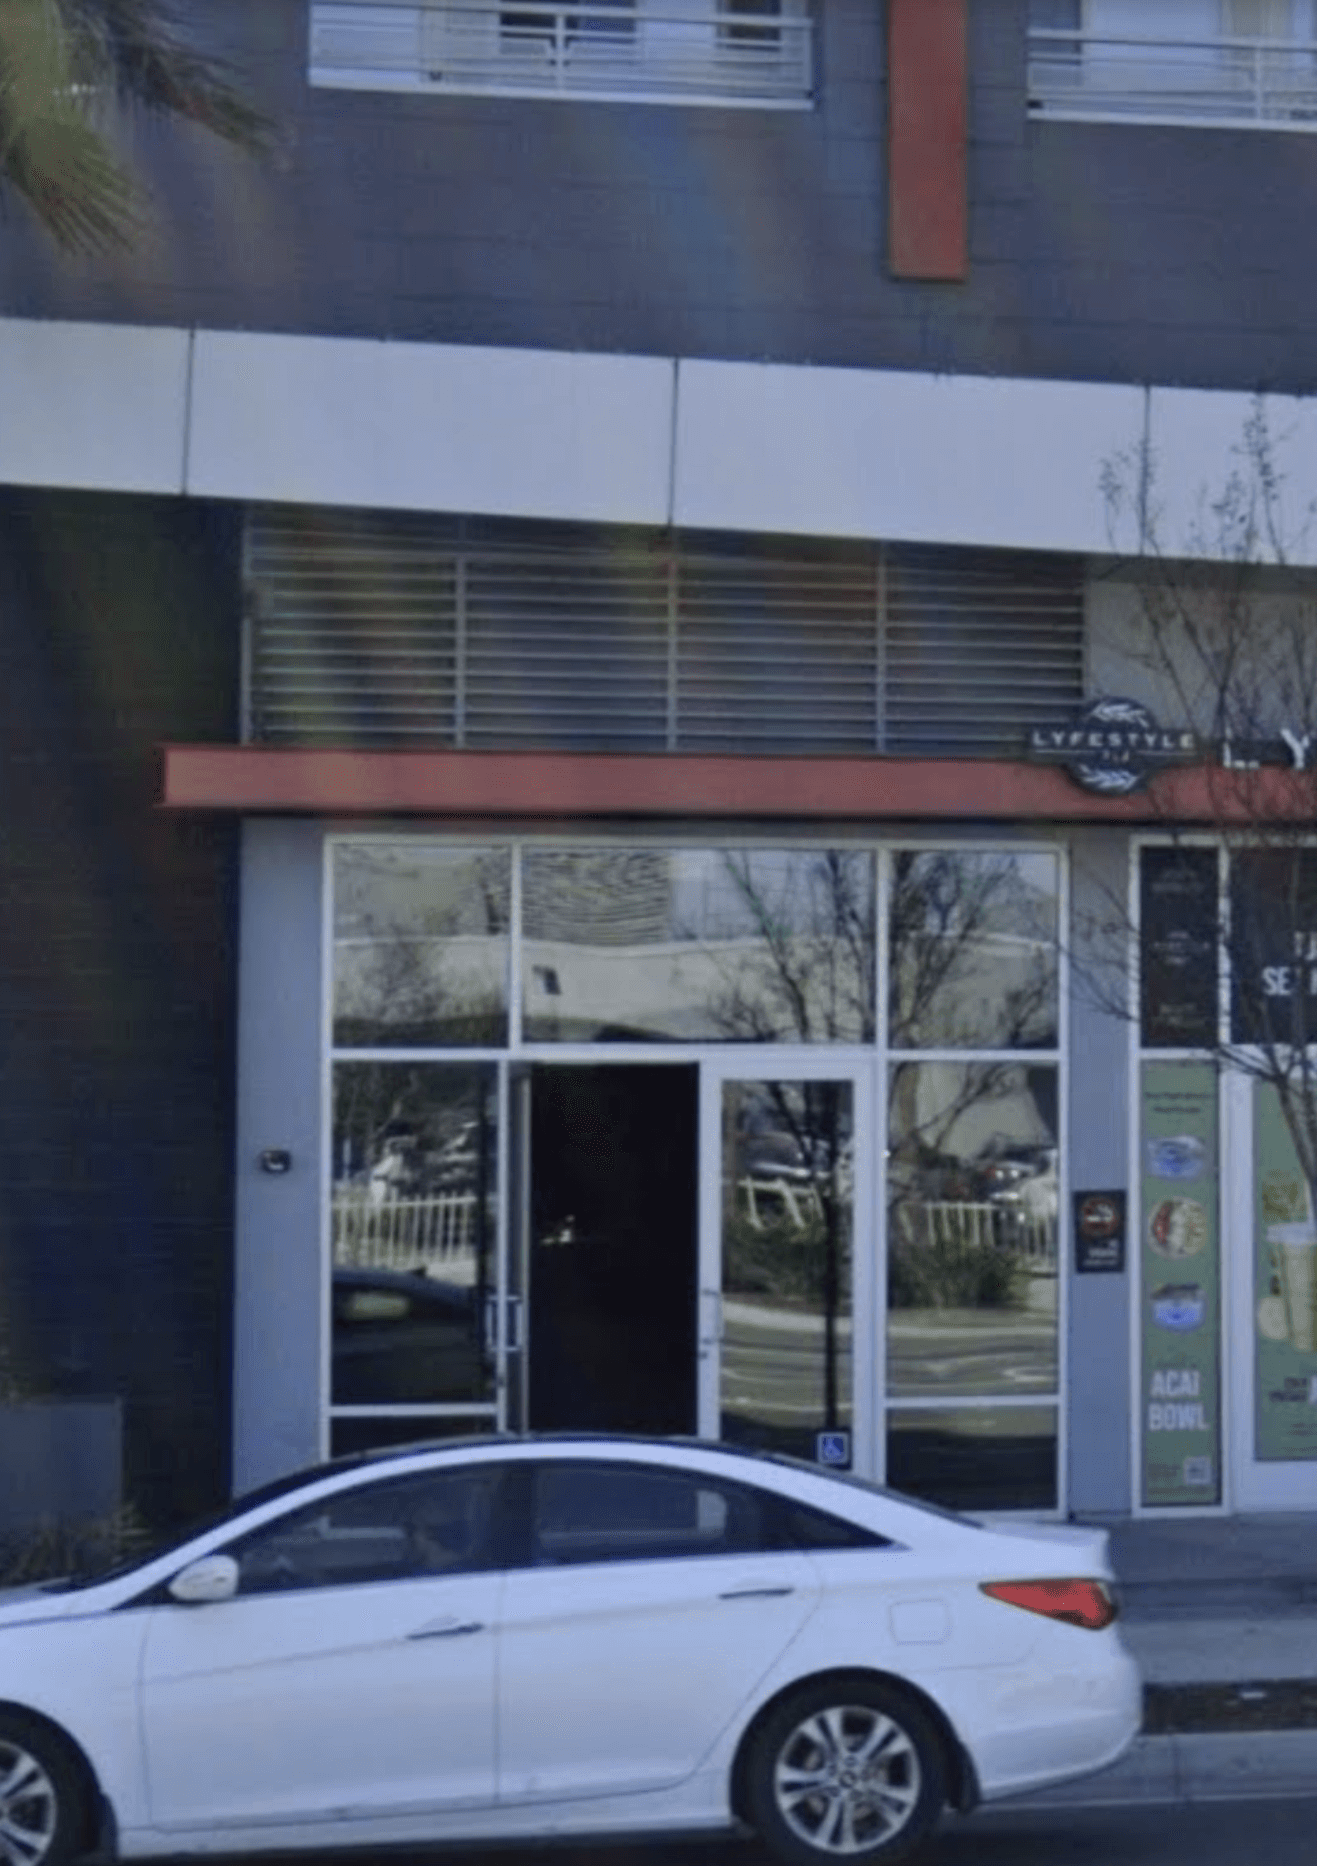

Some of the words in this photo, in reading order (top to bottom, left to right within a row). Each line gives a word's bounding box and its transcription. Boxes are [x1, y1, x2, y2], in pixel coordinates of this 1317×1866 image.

[1031, 730, 1195, 750] LYFESTYLE
[1261, 966, 1303, 996] SE
[1149, 1369, 1201, 1397] ACAI
[1147, 1401, 1211, 1431] BOWL
